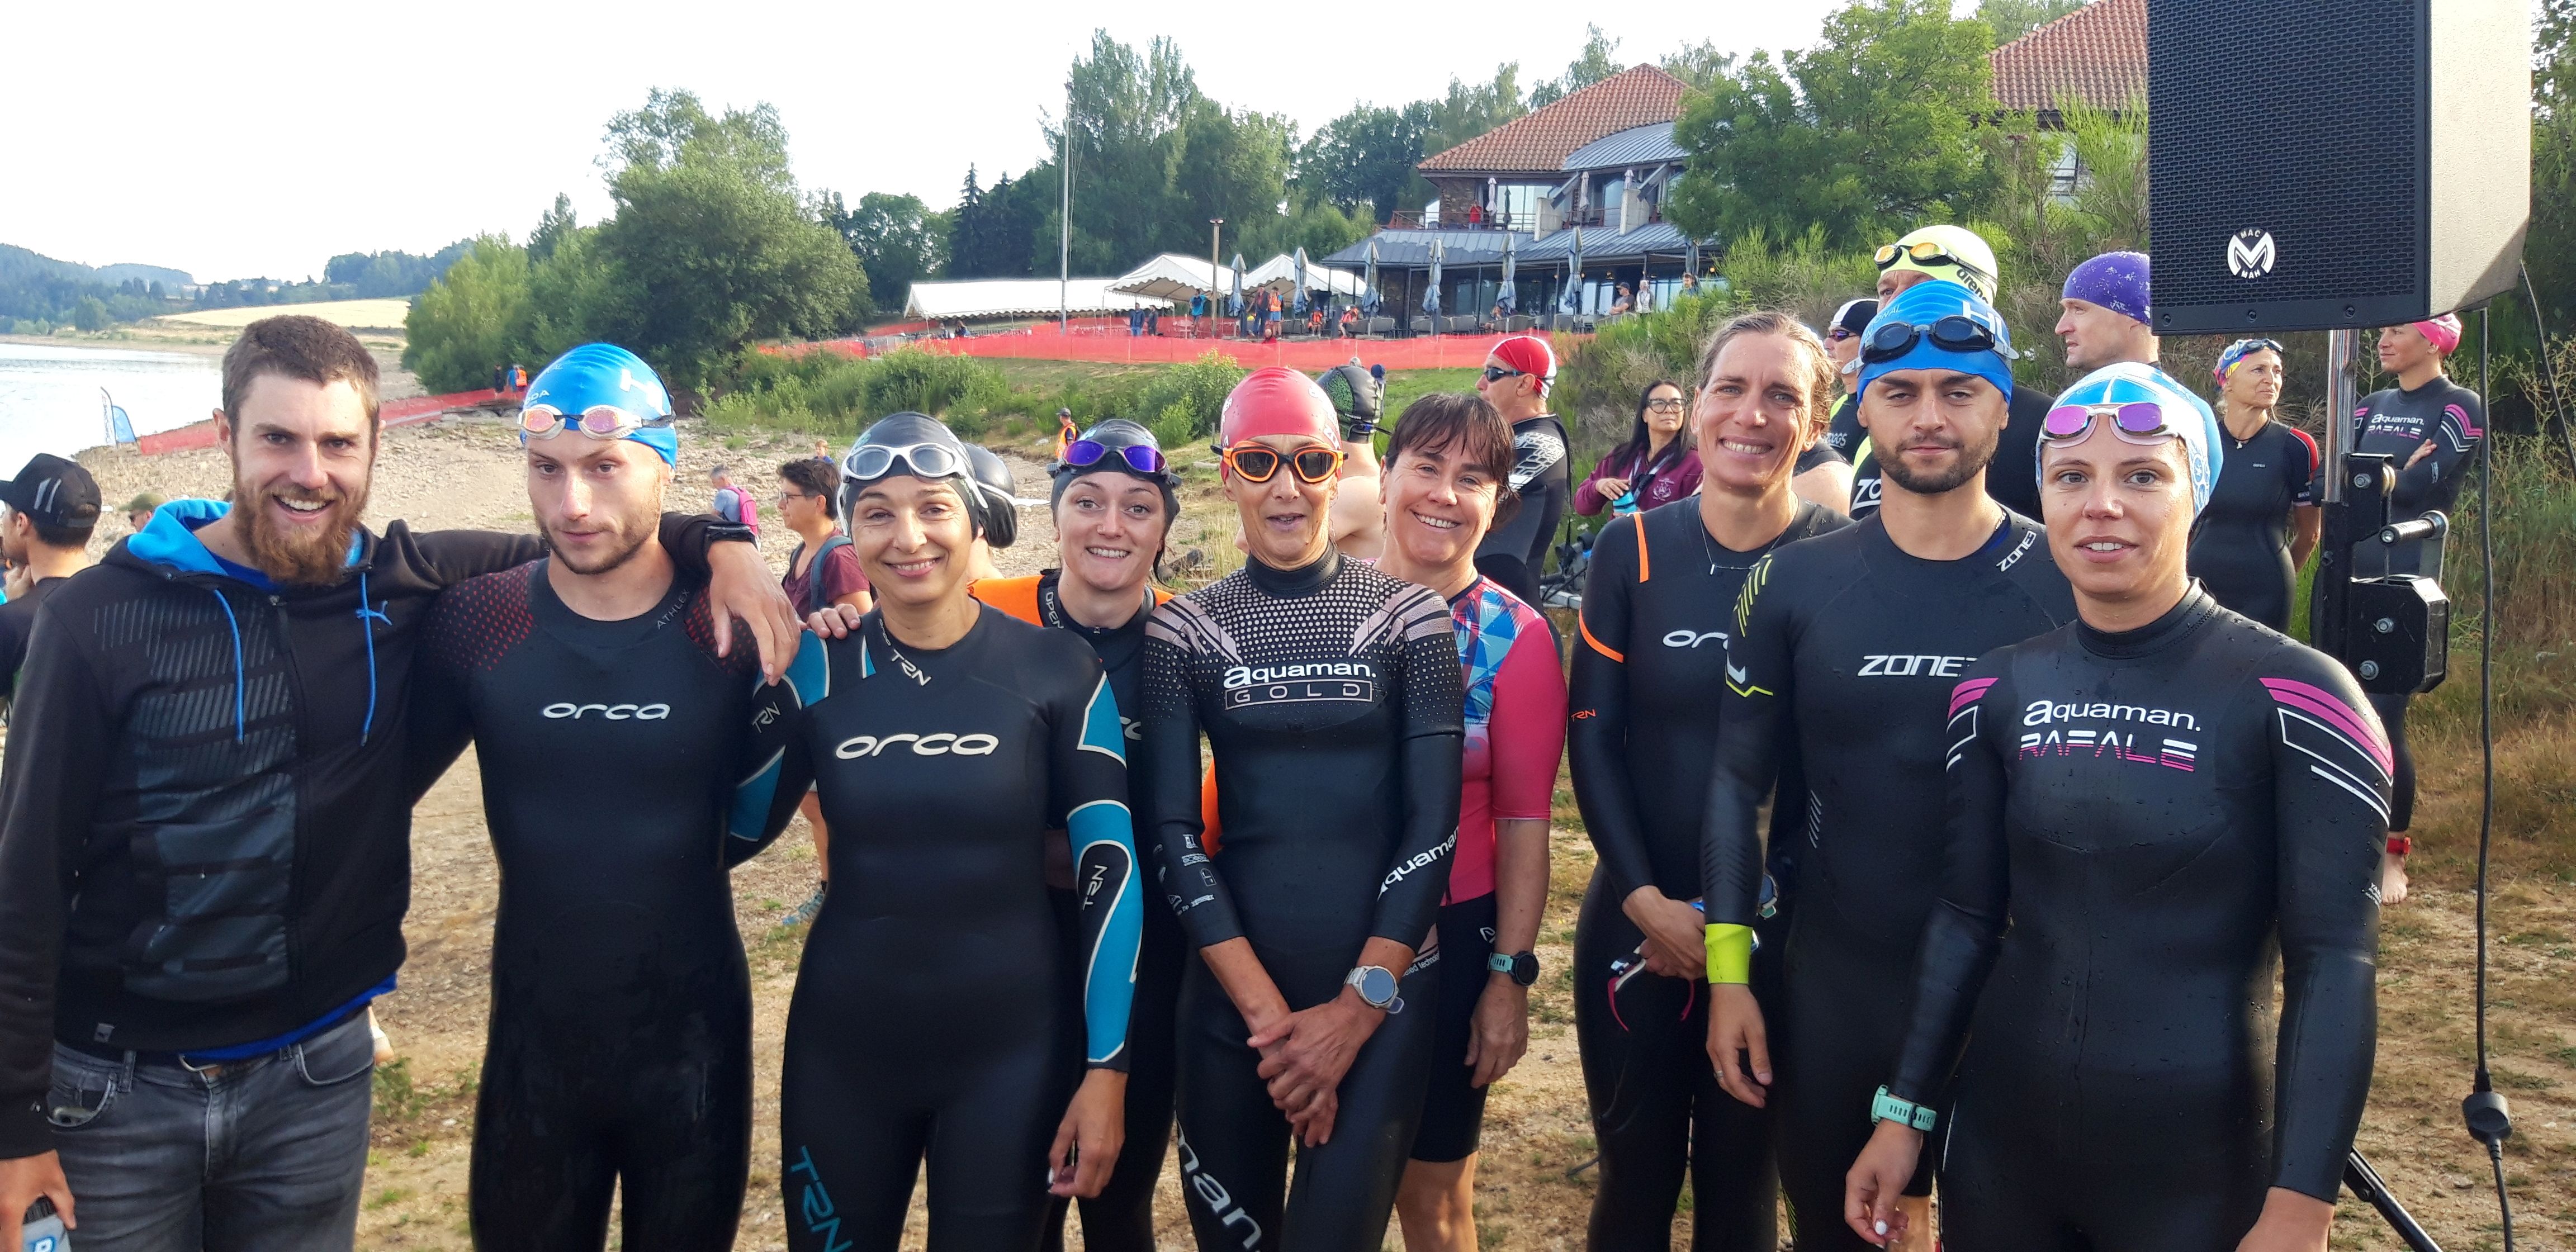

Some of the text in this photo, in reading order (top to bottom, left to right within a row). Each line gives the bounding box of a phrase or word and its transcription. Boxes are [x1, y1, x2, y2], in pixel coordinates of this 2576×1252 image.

[2240, 229, 2261, 239] MAC
[2241, 269, 2261, 279] MAH
[657, 589, 689, 630] ATHLEX
[891, 648, 932, 686] TRN
[1234, 683, 1361, 703] GOLD
[543, 703, 671, 720] orca
[752, 701, 781, 733] TRN
[836, 733, 1000, 760] orca
[2019, 729, 2198, 772] RAFALE
